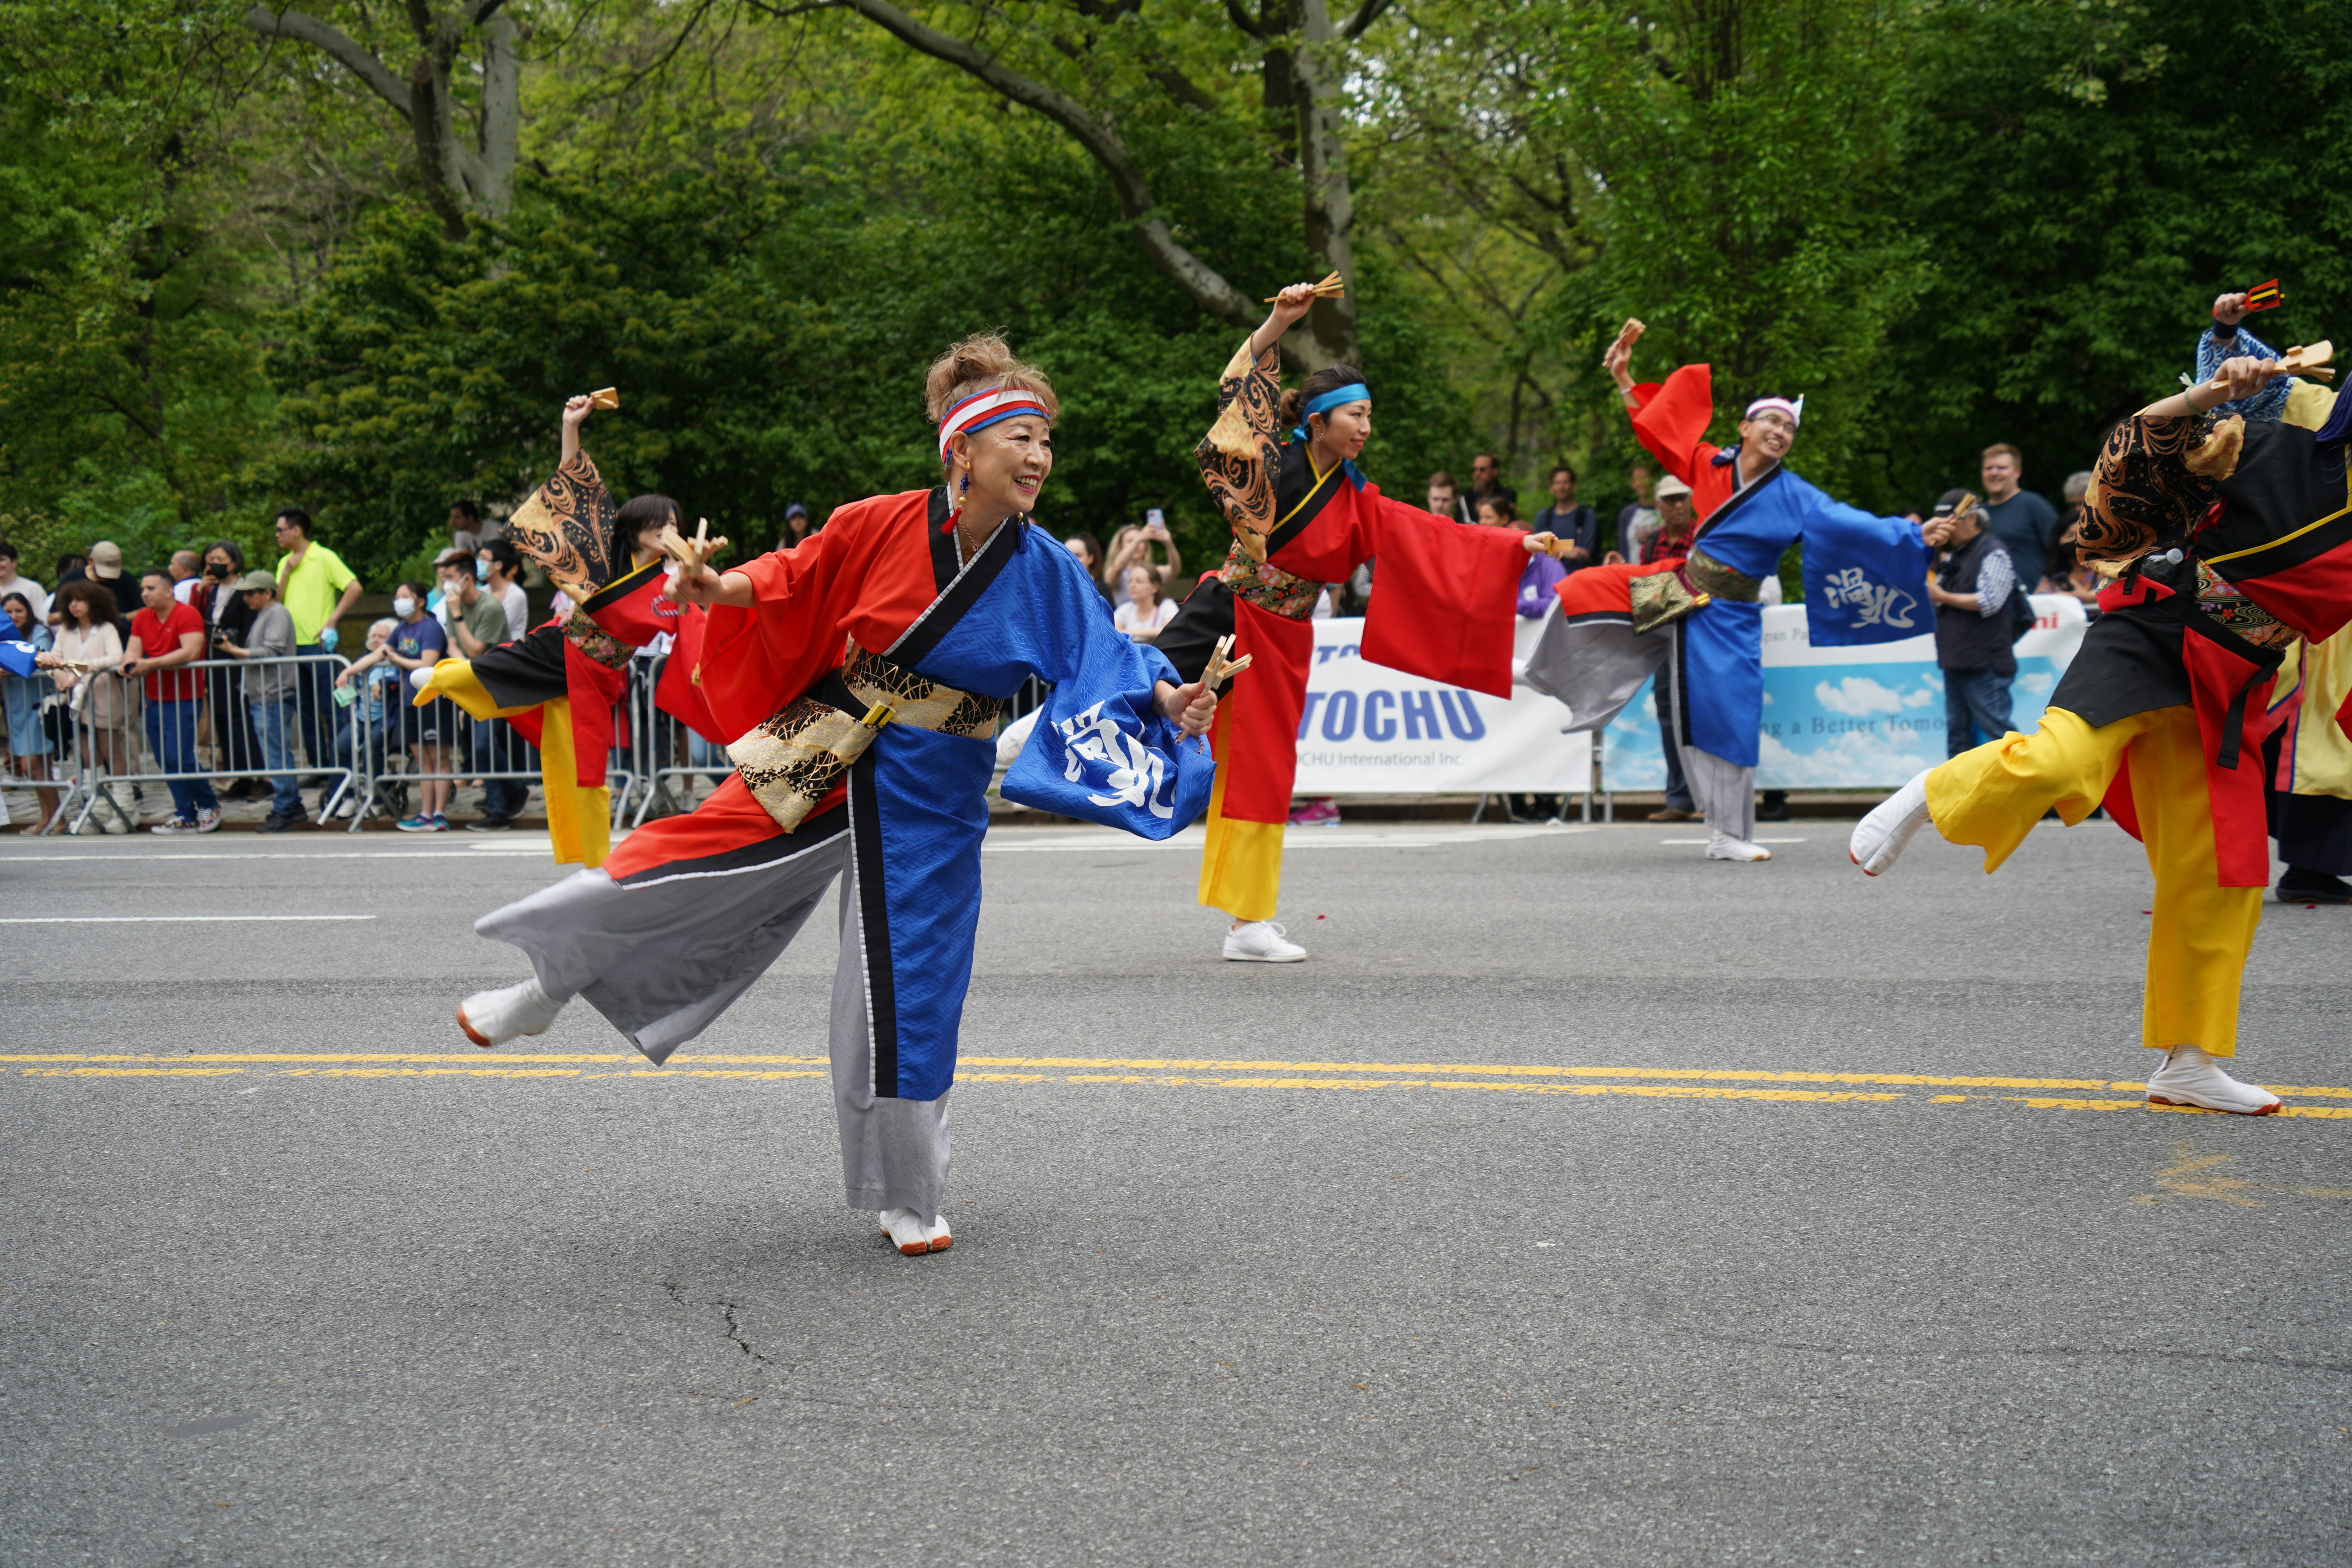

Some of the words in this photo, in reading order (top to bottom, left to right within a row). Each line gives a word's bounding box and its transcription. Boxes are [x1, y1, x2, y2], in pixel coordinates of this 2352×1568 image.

[1762, 632, 1786, 645] pan
[1791, 722, 1800, 734] a
[1812, 716, 1875, 734] Better
[1339, 751, 1435, 766] International
[1439, 752, 1465, 766] Inc.
